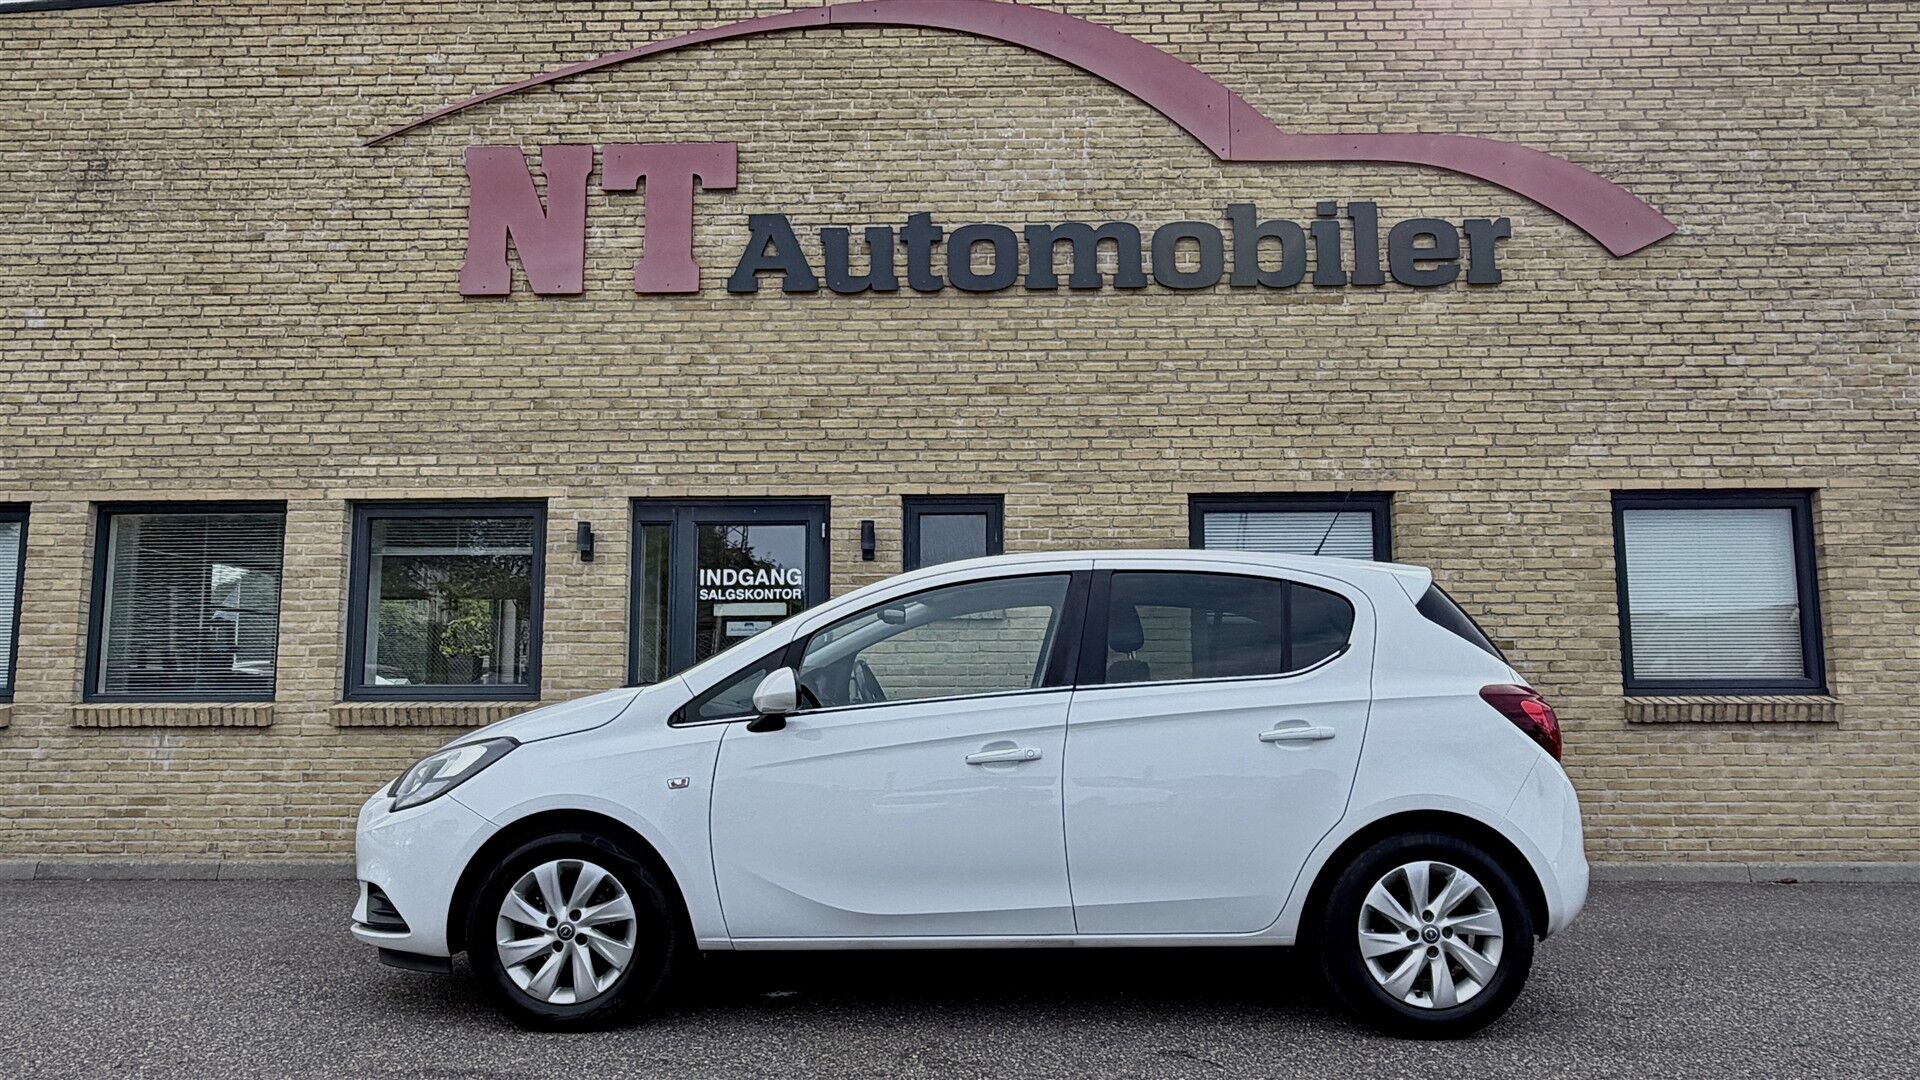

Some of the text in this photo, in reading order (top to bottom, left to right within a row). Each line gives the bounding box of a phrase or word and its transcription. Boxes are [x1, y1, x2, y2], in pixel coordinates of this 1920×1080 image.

[459, 142, 1512, 296] NT Automobiler
[699, 568, 802, 586] INDGANG
[699, 588, 802, 600] SALGSKONTOR
